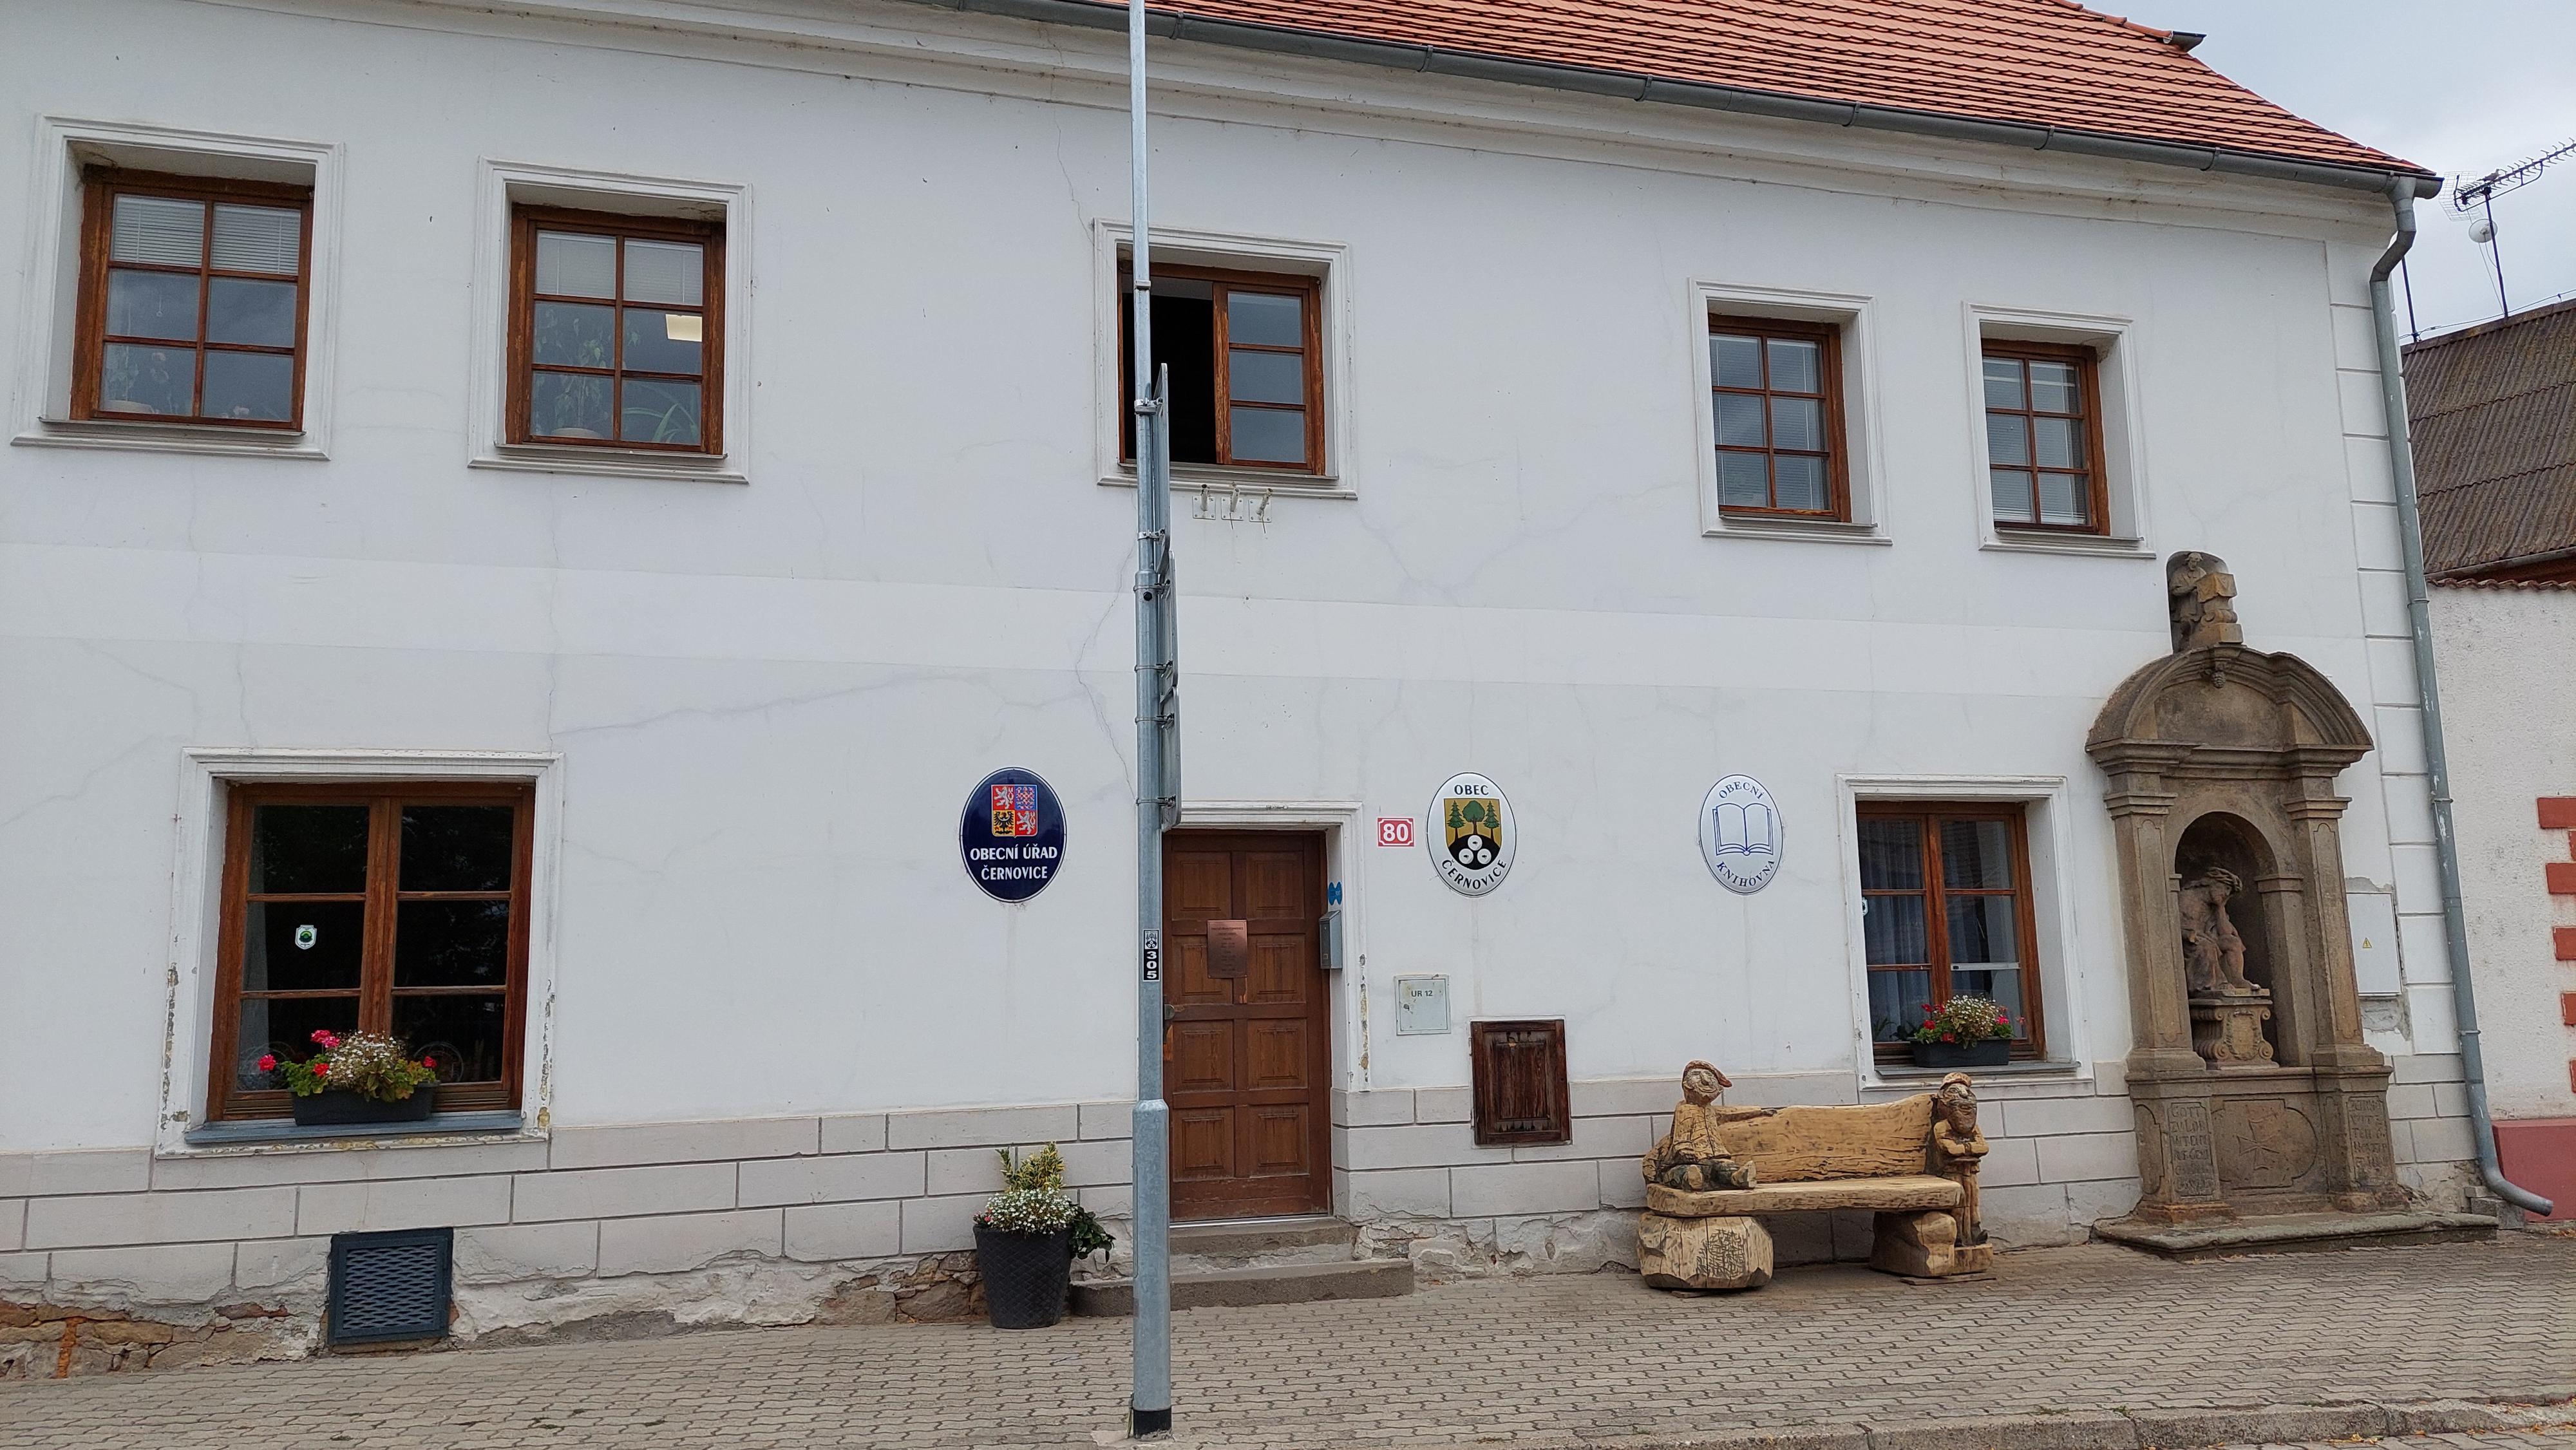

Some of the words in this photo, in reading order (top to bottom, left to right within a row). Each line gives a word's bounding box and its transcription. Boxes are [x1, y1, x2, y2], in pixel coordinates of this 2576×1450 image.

[1454, 784, 1489, 796] OBEC
[1719, 781, 1765, 800] OBECNÍ
[1383, 824, 1409, 842] 80
[970, 844, 1018, 860] OBECNÍ
[1023, 843, 1057, 859] ÚŘAD
[981, 865, 1048, 880] ČERNOVICE
[1441, 859, 1507, 890] ČERNOVICE
[1716, 860, 1775, 887] KNIHOVNA
[1146, 951, 1157, 979] 305
